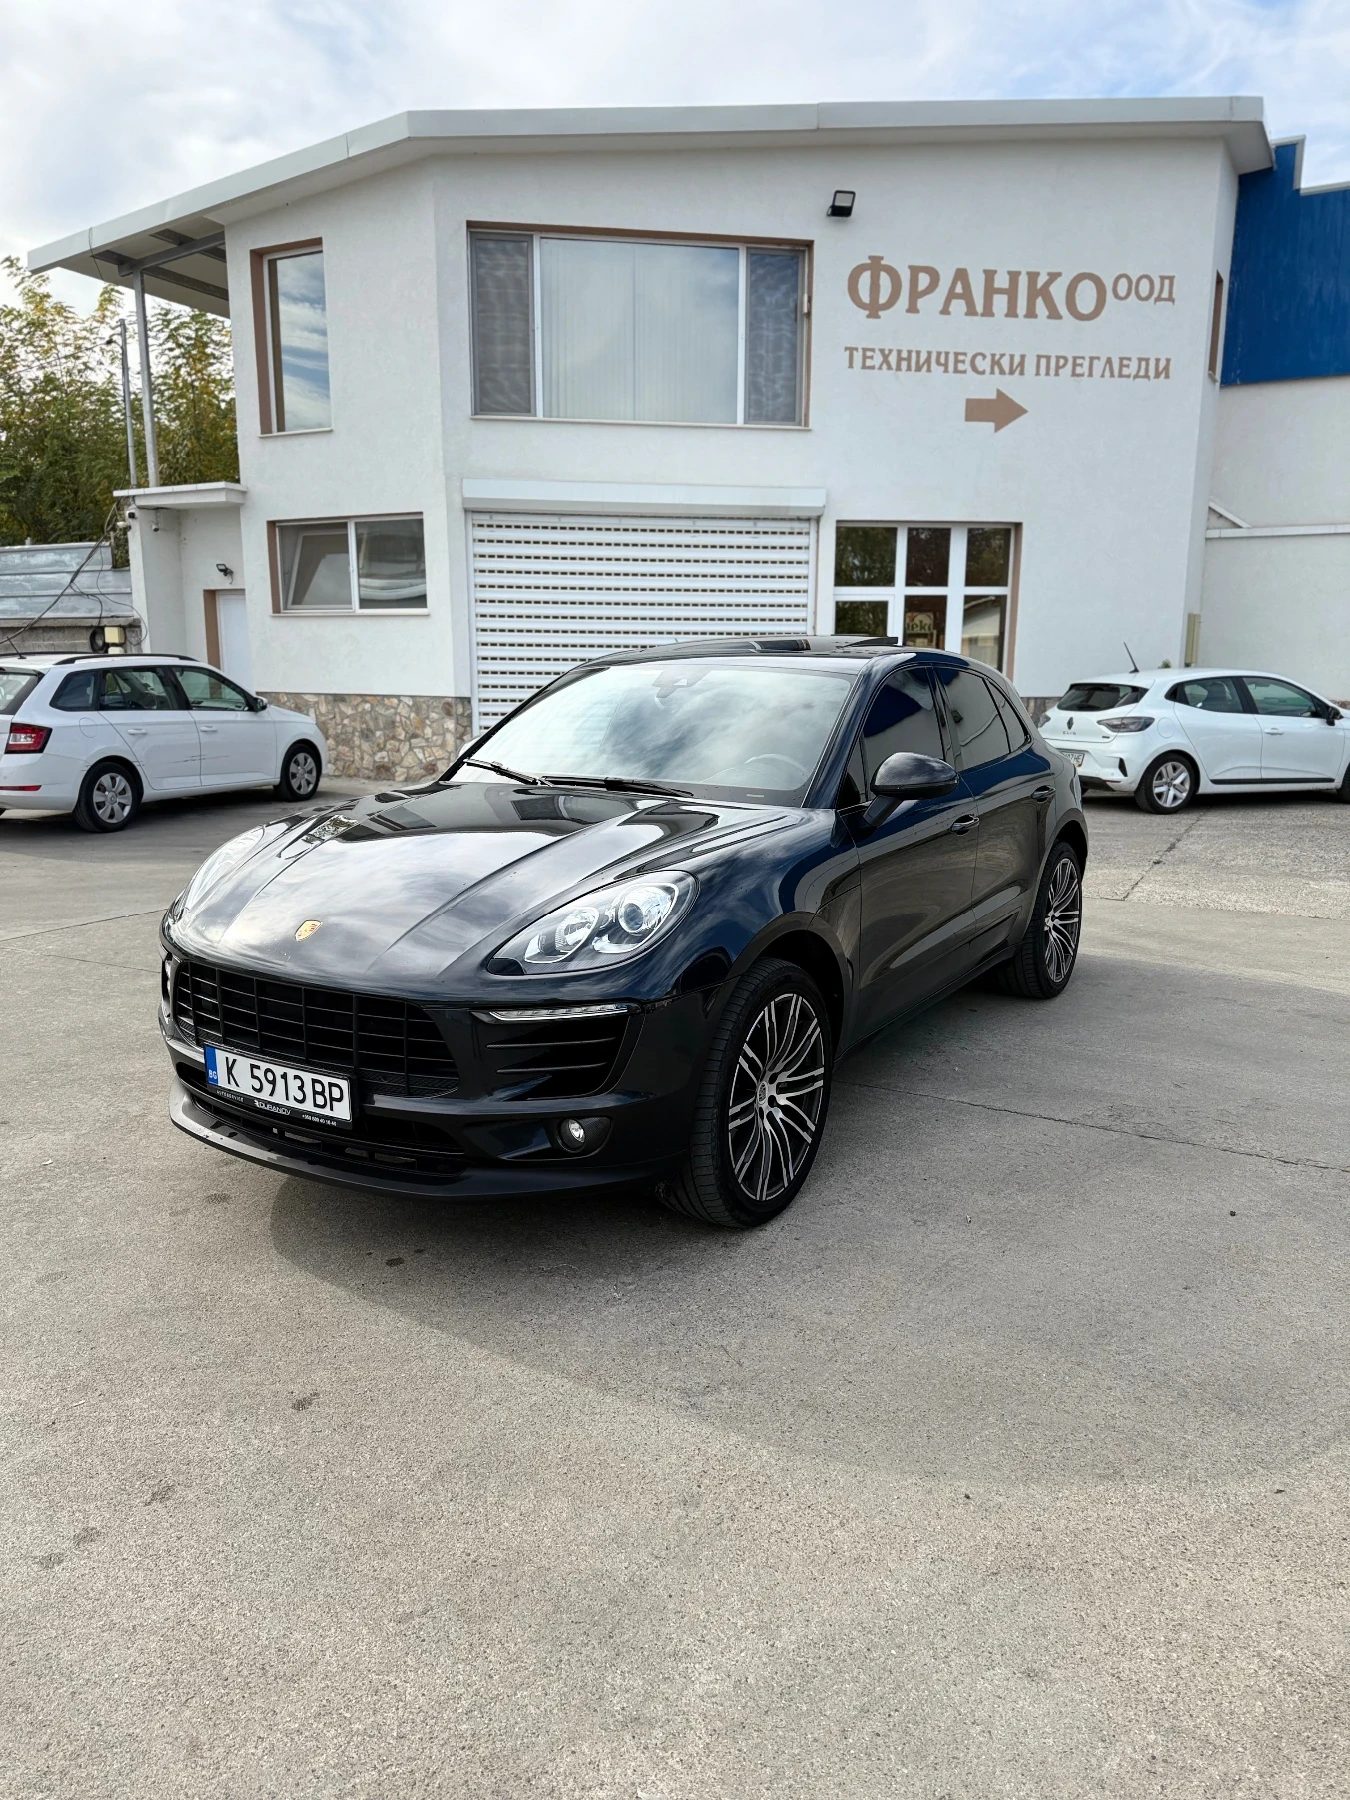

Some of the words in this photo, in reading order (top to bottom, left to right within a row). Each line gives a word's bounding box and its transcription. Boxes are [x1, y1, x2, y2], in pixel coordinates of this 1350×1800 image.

[847, 255, 1107, 321] ФРАНКО
[1112, 273, 1176, 306] ООД
[844, 346, 1026, 377] ТЕХНИЧЕСКИ
[1034, 354, 1172, 382] ПРЕГЛЕДИ
[208, 1069, 218, 1080] BG
[225, 1056, 241, 1088] K
